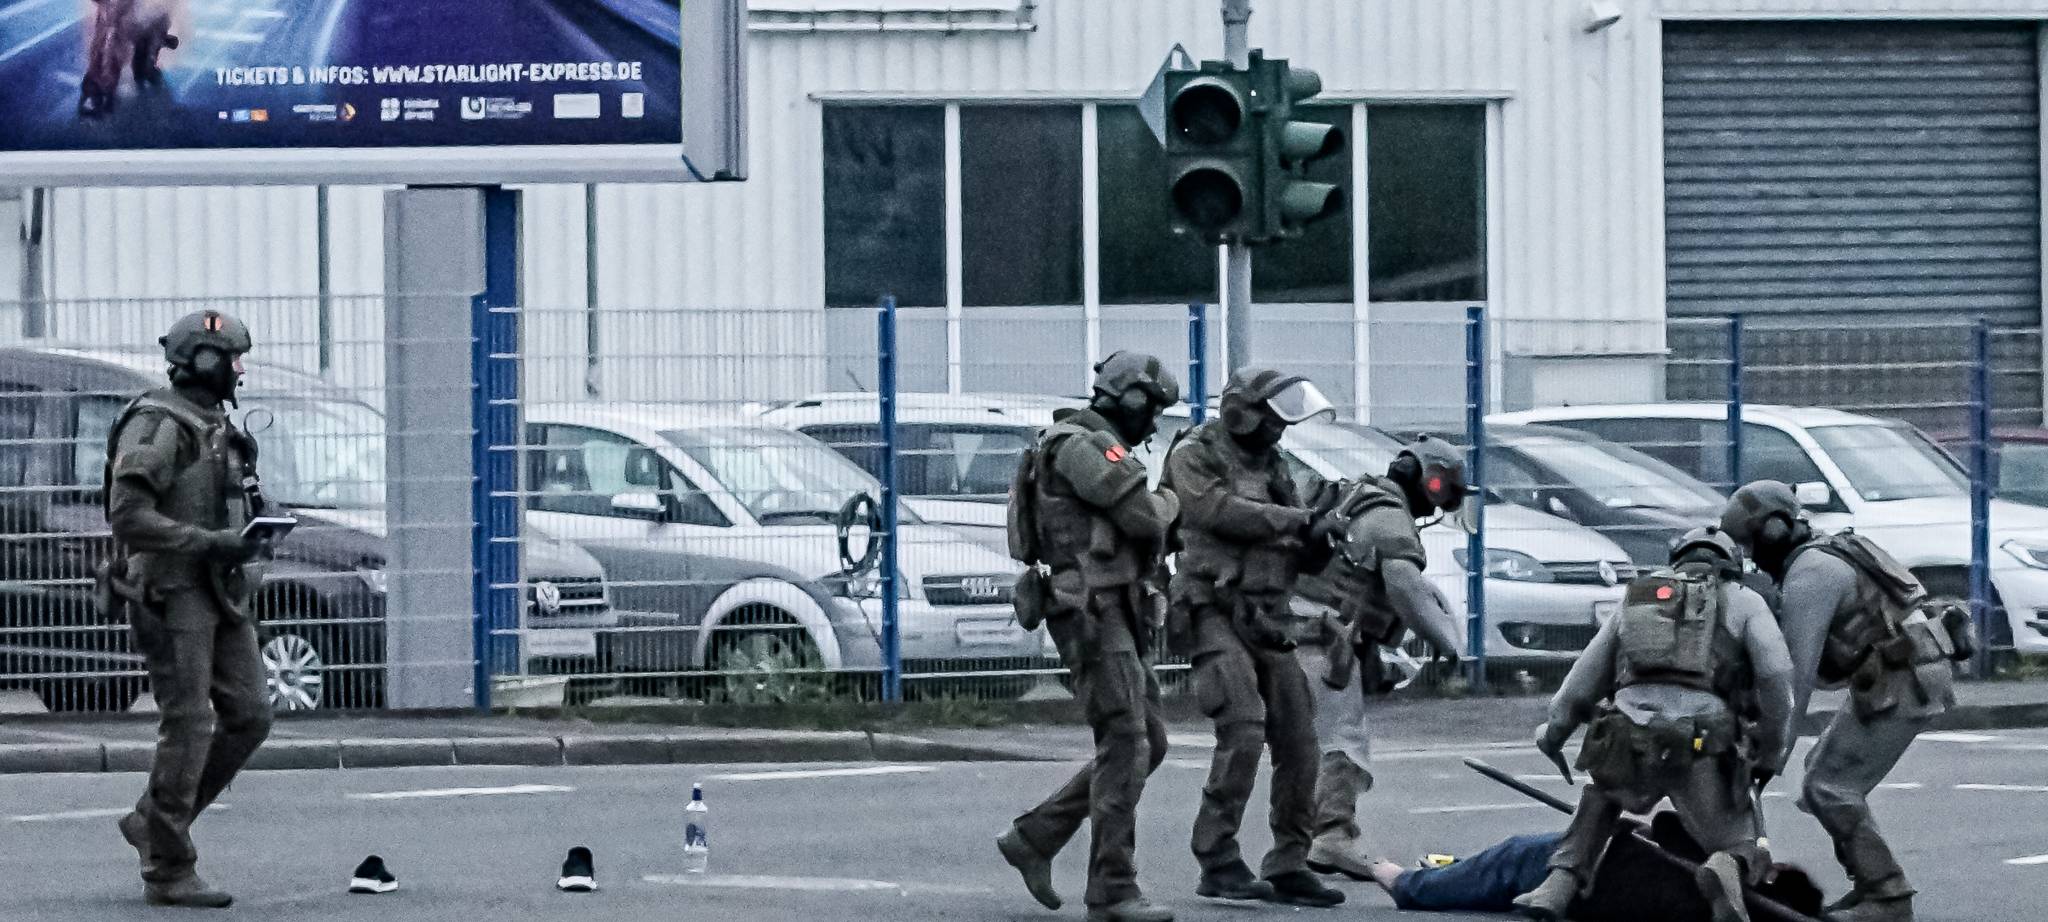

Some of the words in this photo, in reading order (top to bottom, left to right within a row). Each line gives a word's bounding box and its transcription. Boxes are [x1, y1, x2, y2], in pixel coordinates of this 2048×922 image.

[216, 65, 288, 86] TICKETS
[292, 65, 305, 85] &
[309, 65, 369, 86] INFOS:
[373, 61, 643, 85] WWW.STARLIGHT-EXPRESS.DE
